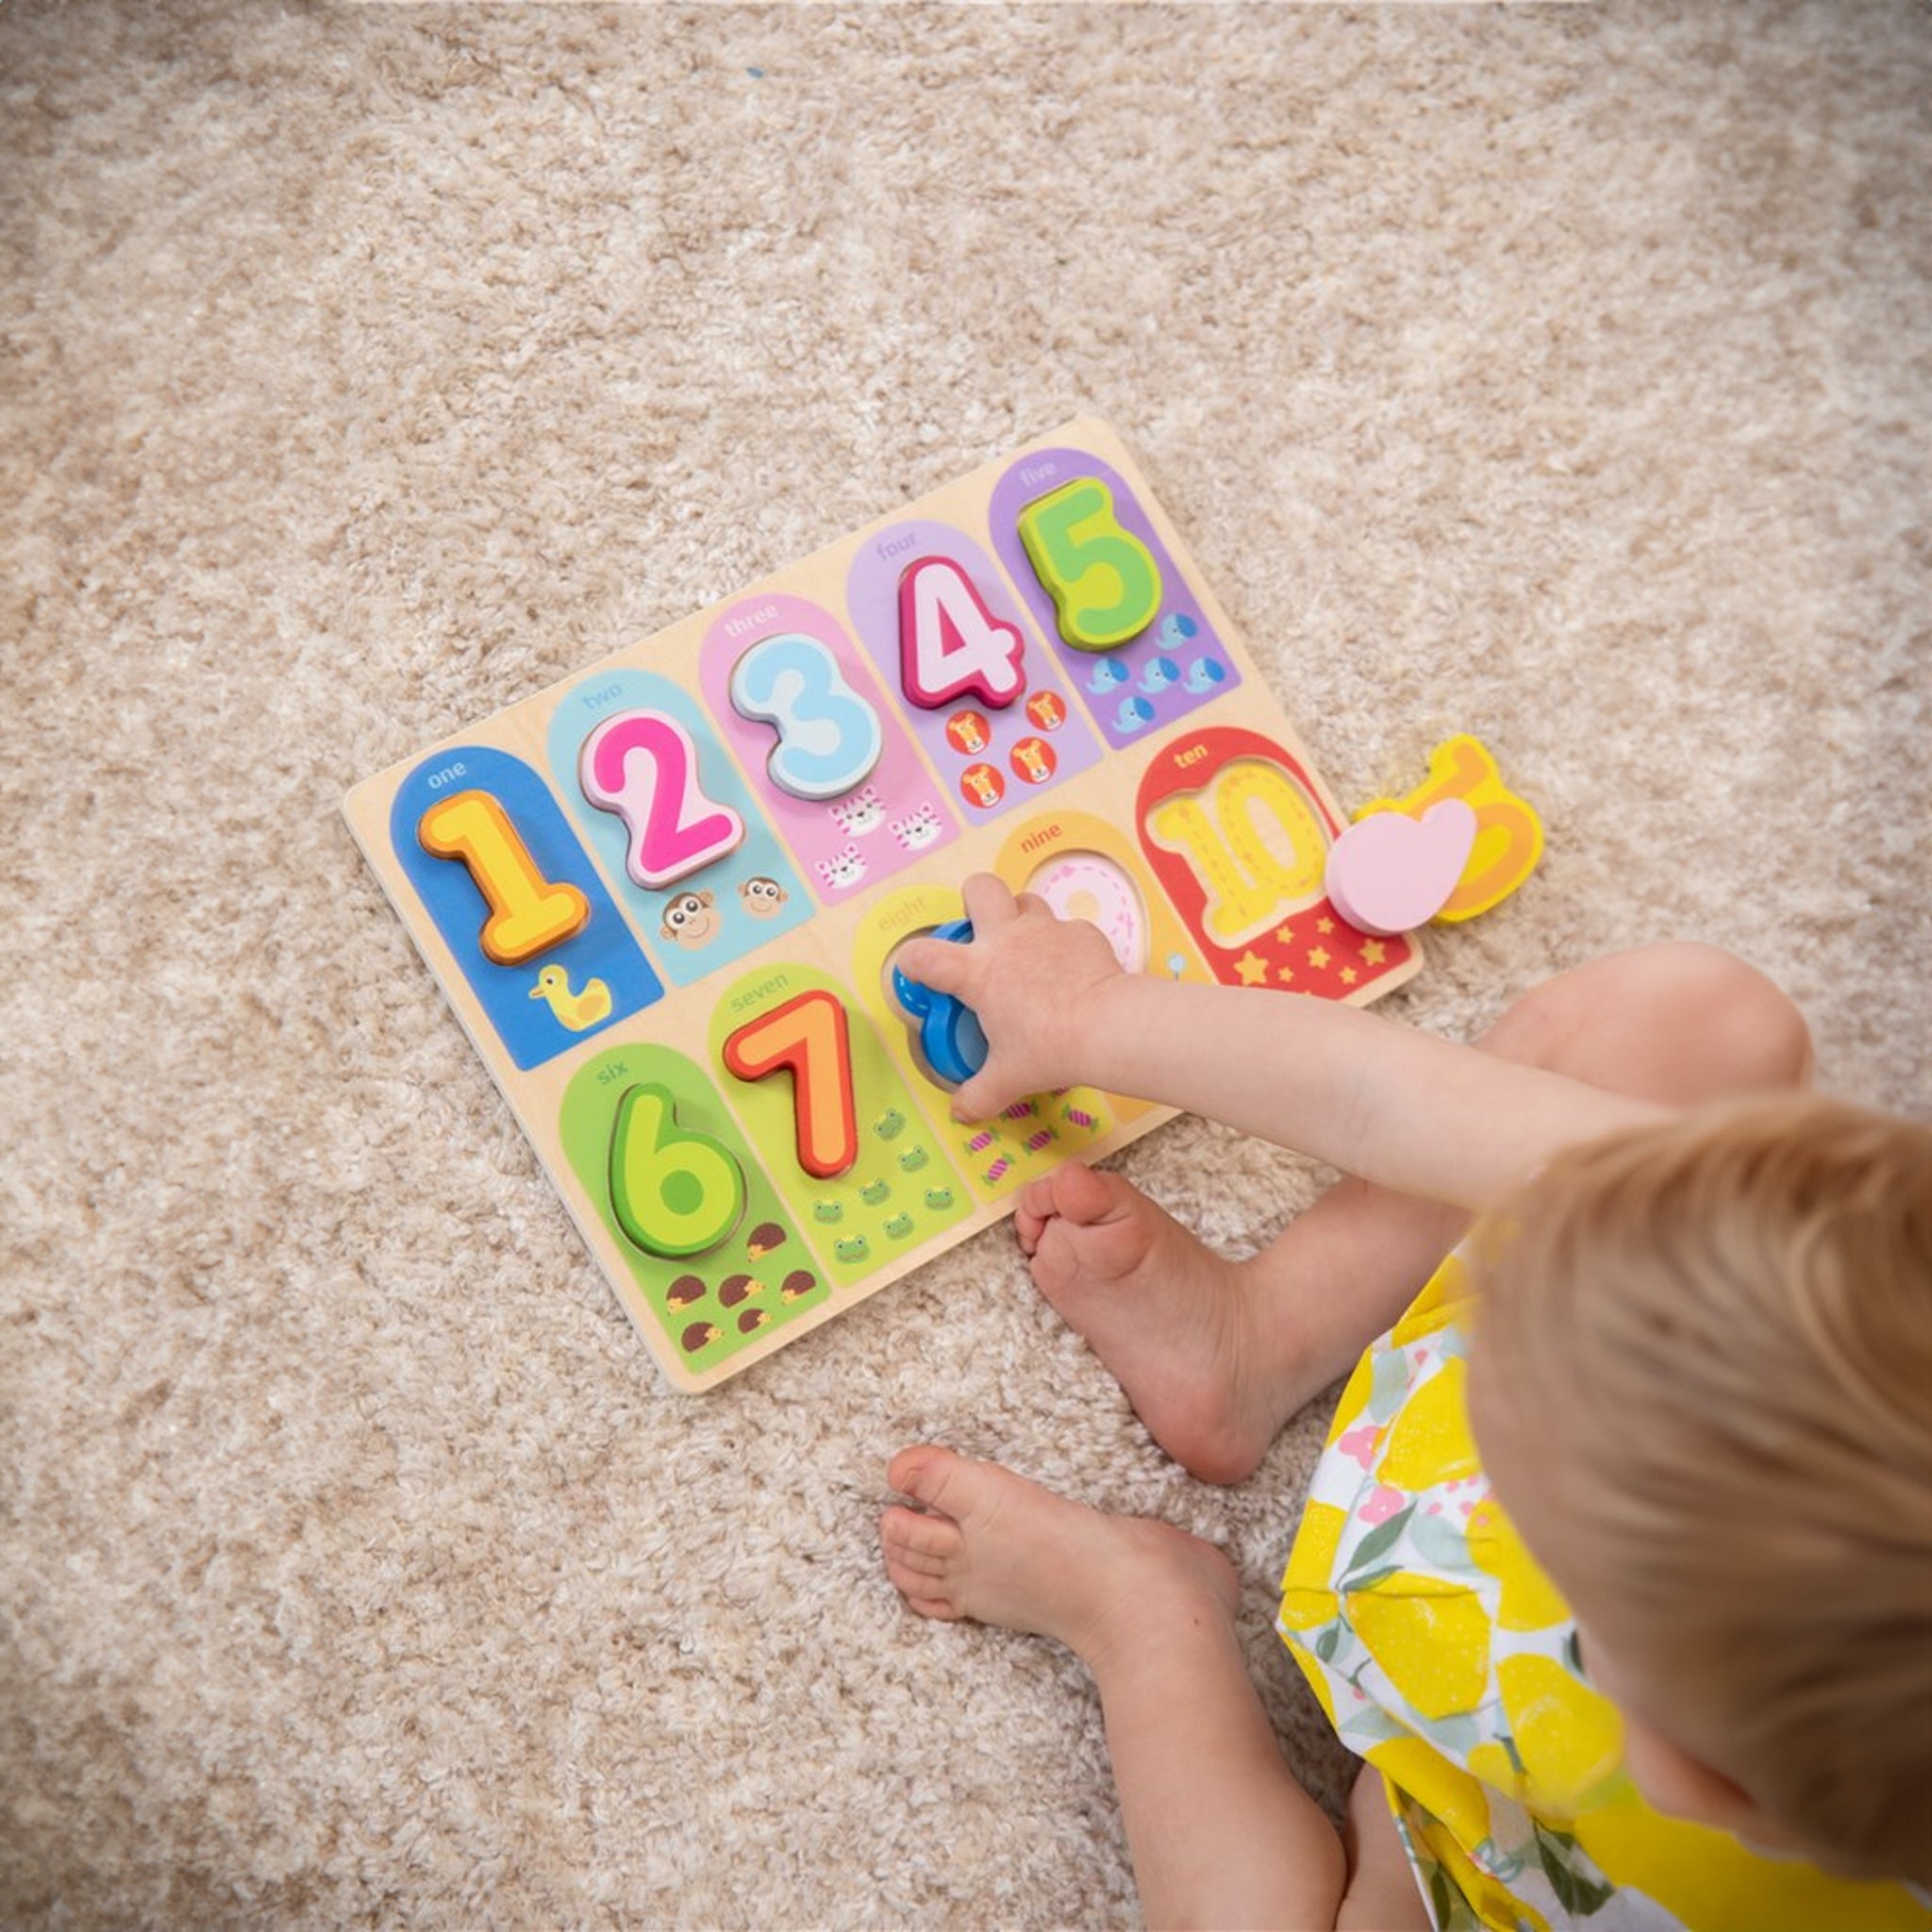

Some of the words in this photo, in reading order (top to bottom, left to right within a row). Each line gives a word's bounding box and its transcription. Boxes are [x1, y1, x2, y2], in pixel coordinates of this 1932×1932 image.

[875, 533, 915, 561] four
[1028, 481, 1158, 644] 5
[724, 605, 779, 638] three
[907, 559, 1022, 701] 4
[581, 684, 623, 710] two
[738, 637, 877, 791] 3
[427, 761, 467, 790] one
[588, 712, 739, 881] 2
[1174, 743, 1208, 769] ten
[424, 794, 584, 961] 1
[1020, 824, 1063, 854] nine
[1155, 762, 1326, 937] 10
[731, 974, 789, 1013] seven
[596, 1061, 629, 1085] six
[730, 993, 852, 1172] 7
[618, 1088, 741, 1253] 6
